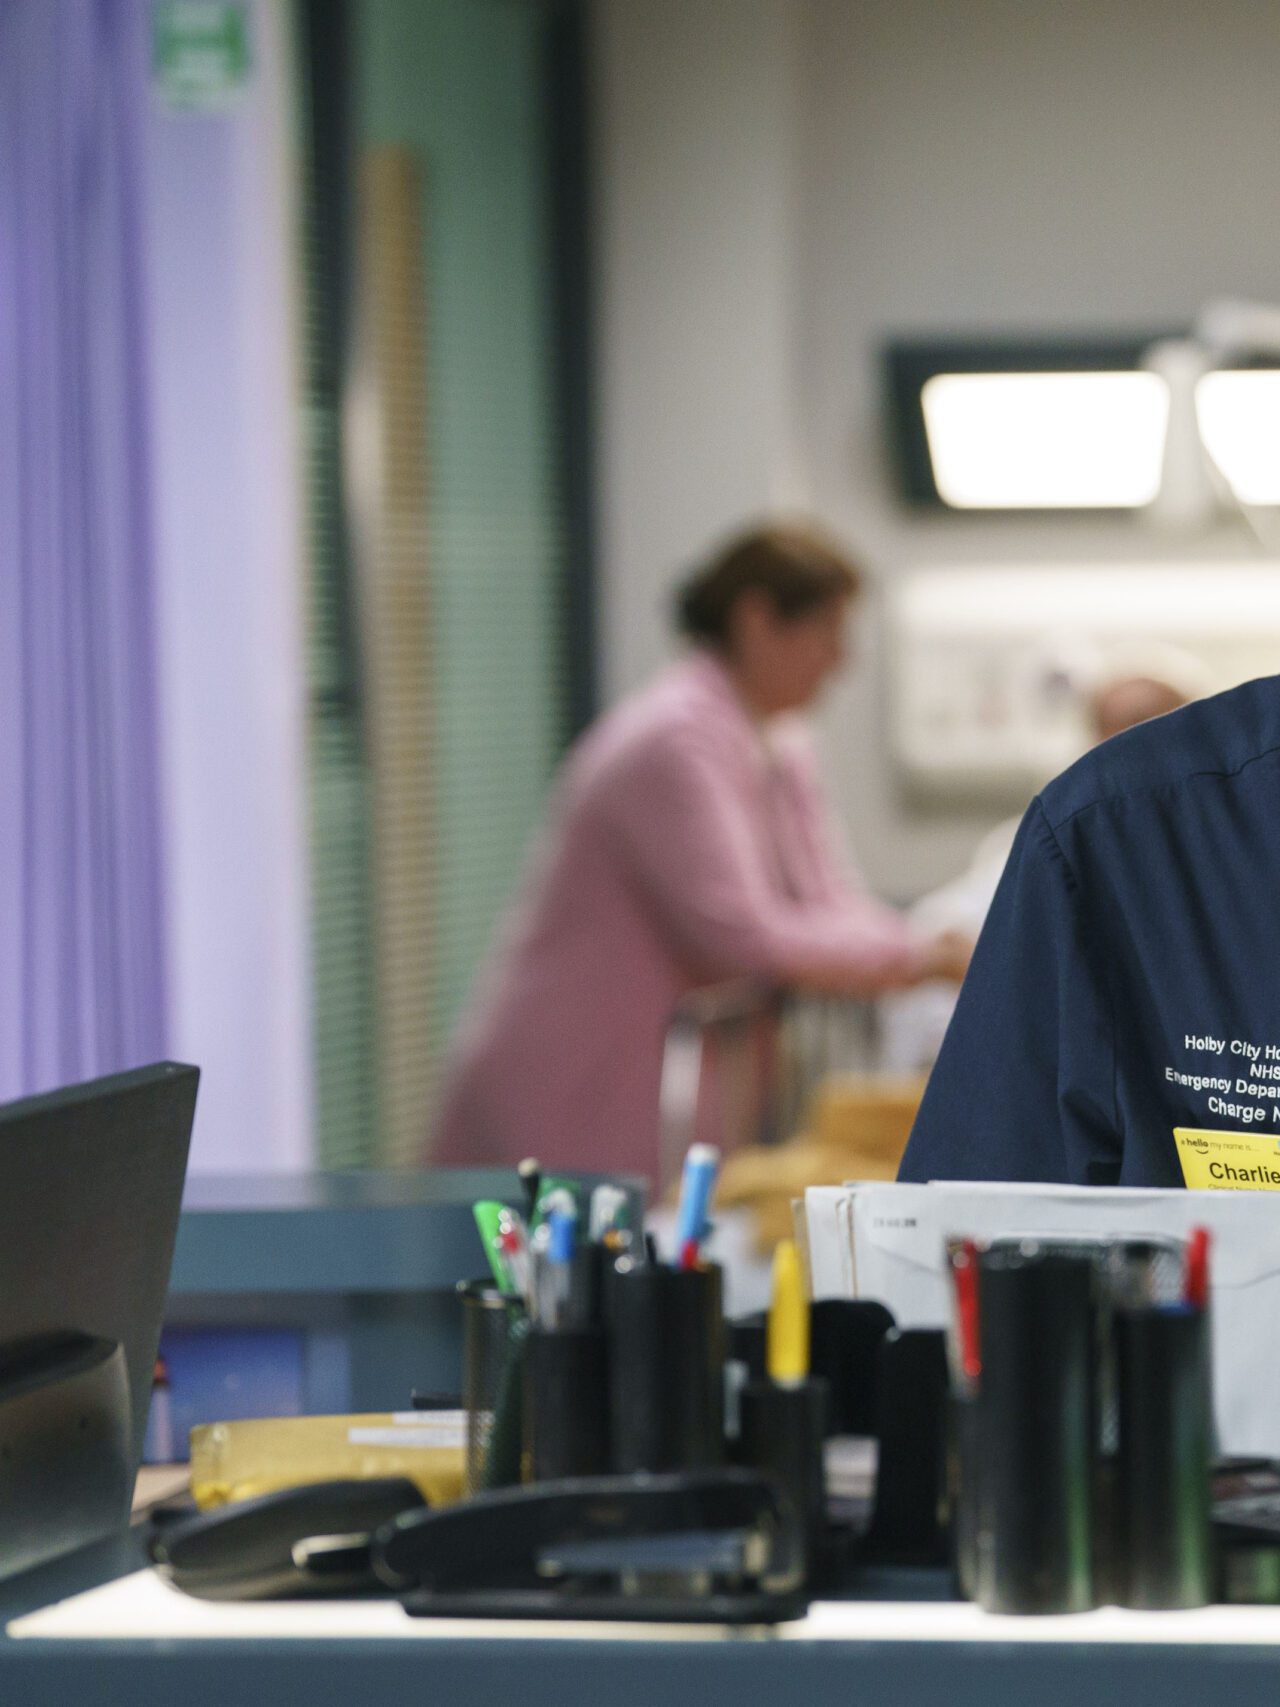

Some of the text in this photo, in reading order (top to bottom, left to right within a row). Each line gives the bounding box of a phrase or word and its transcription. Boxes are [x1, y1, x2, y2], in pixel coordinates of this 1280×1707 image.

[1184, 1034, 1226, 1055] Holby
[1230, 1039, 1261, 1061] City
[1208, 1096, 1266, 1123] Charge
